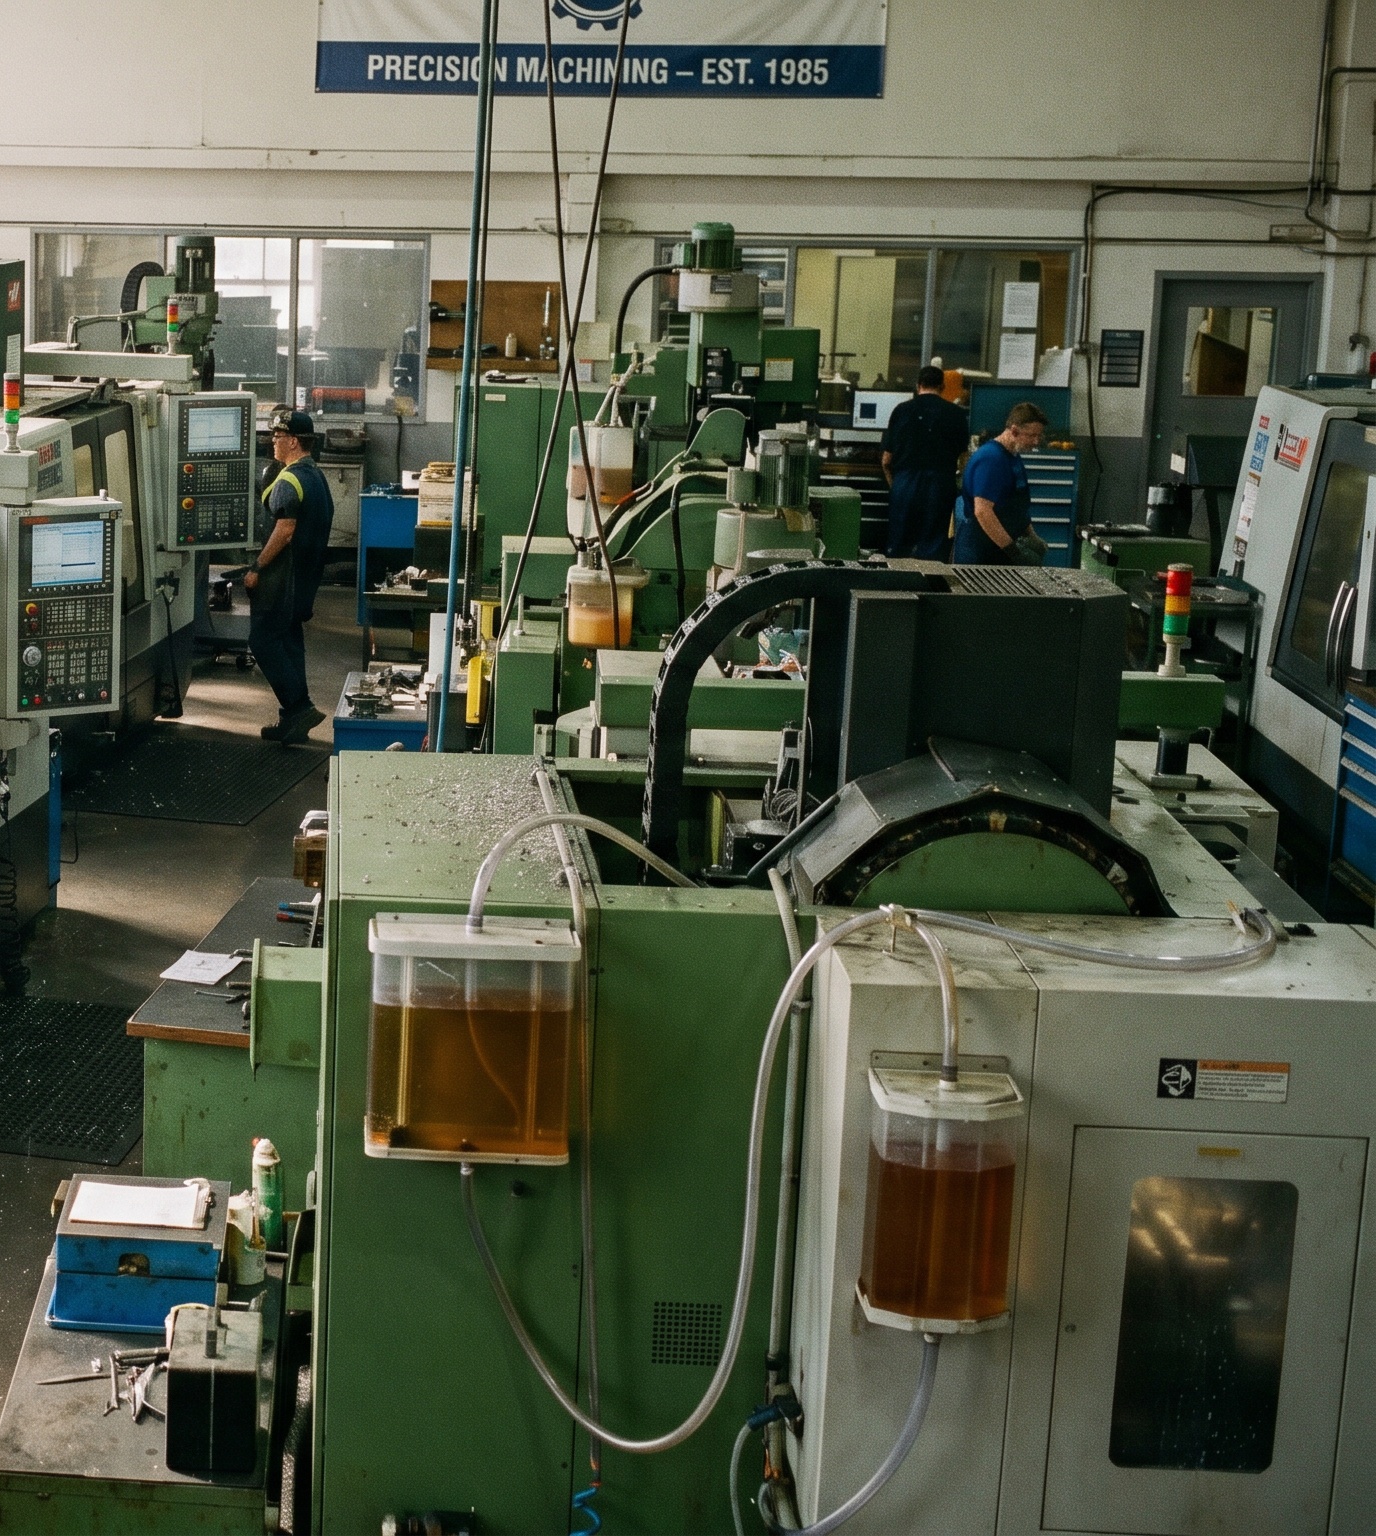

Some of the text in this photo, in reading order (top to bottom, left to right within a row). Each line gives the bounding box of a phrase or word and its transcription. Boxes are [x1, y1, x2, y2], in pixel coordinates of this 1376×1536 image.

[367, 54, 508, 83] PRECISION
[516, 56, 669, 85] MACHINING
[701, 58, 754, 85] EST.
[765, 58, 829, 85] 1985
